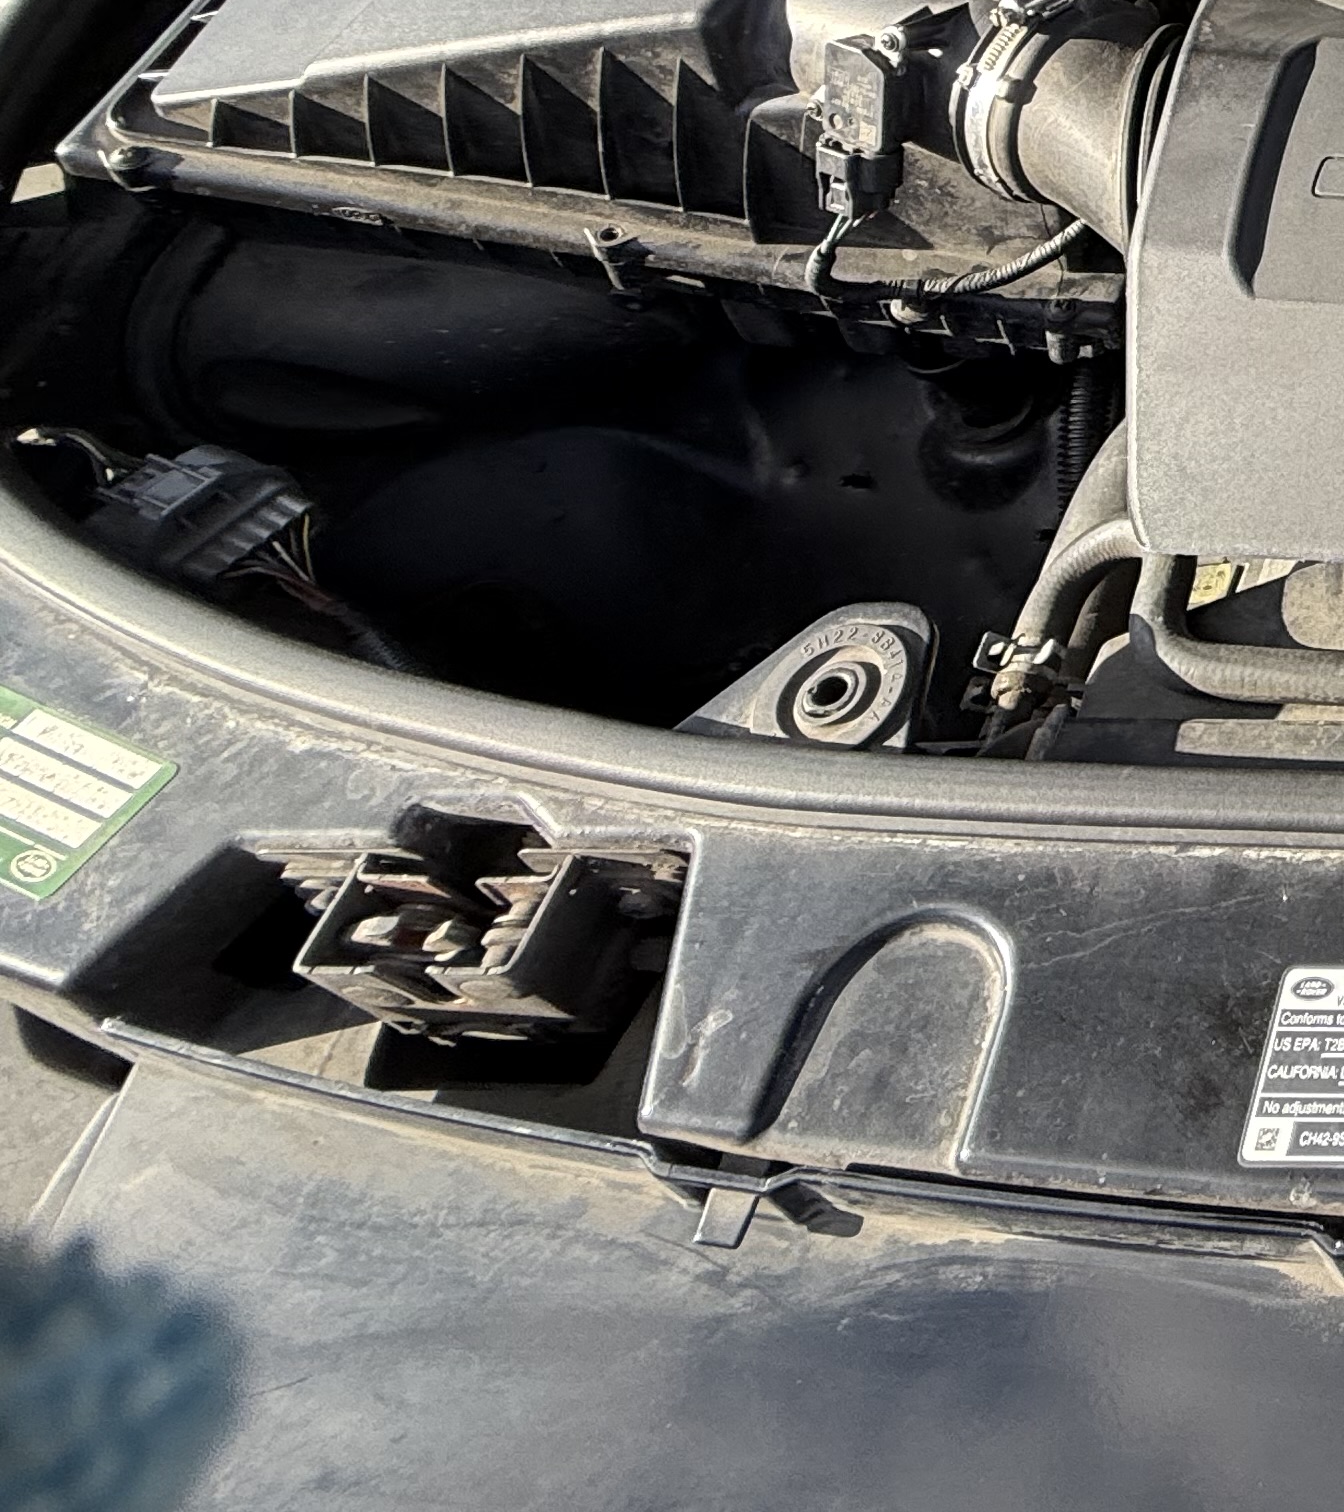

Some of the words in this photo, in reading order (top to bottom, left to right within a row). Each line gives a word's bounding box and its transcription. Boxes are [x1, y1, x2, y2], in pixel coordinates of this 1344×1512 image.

[1280, 1011, 1334, 1025] Conforms
[1273, 1038, 1291, 1051] US
[1262, 1100, 1280, 1114] No
